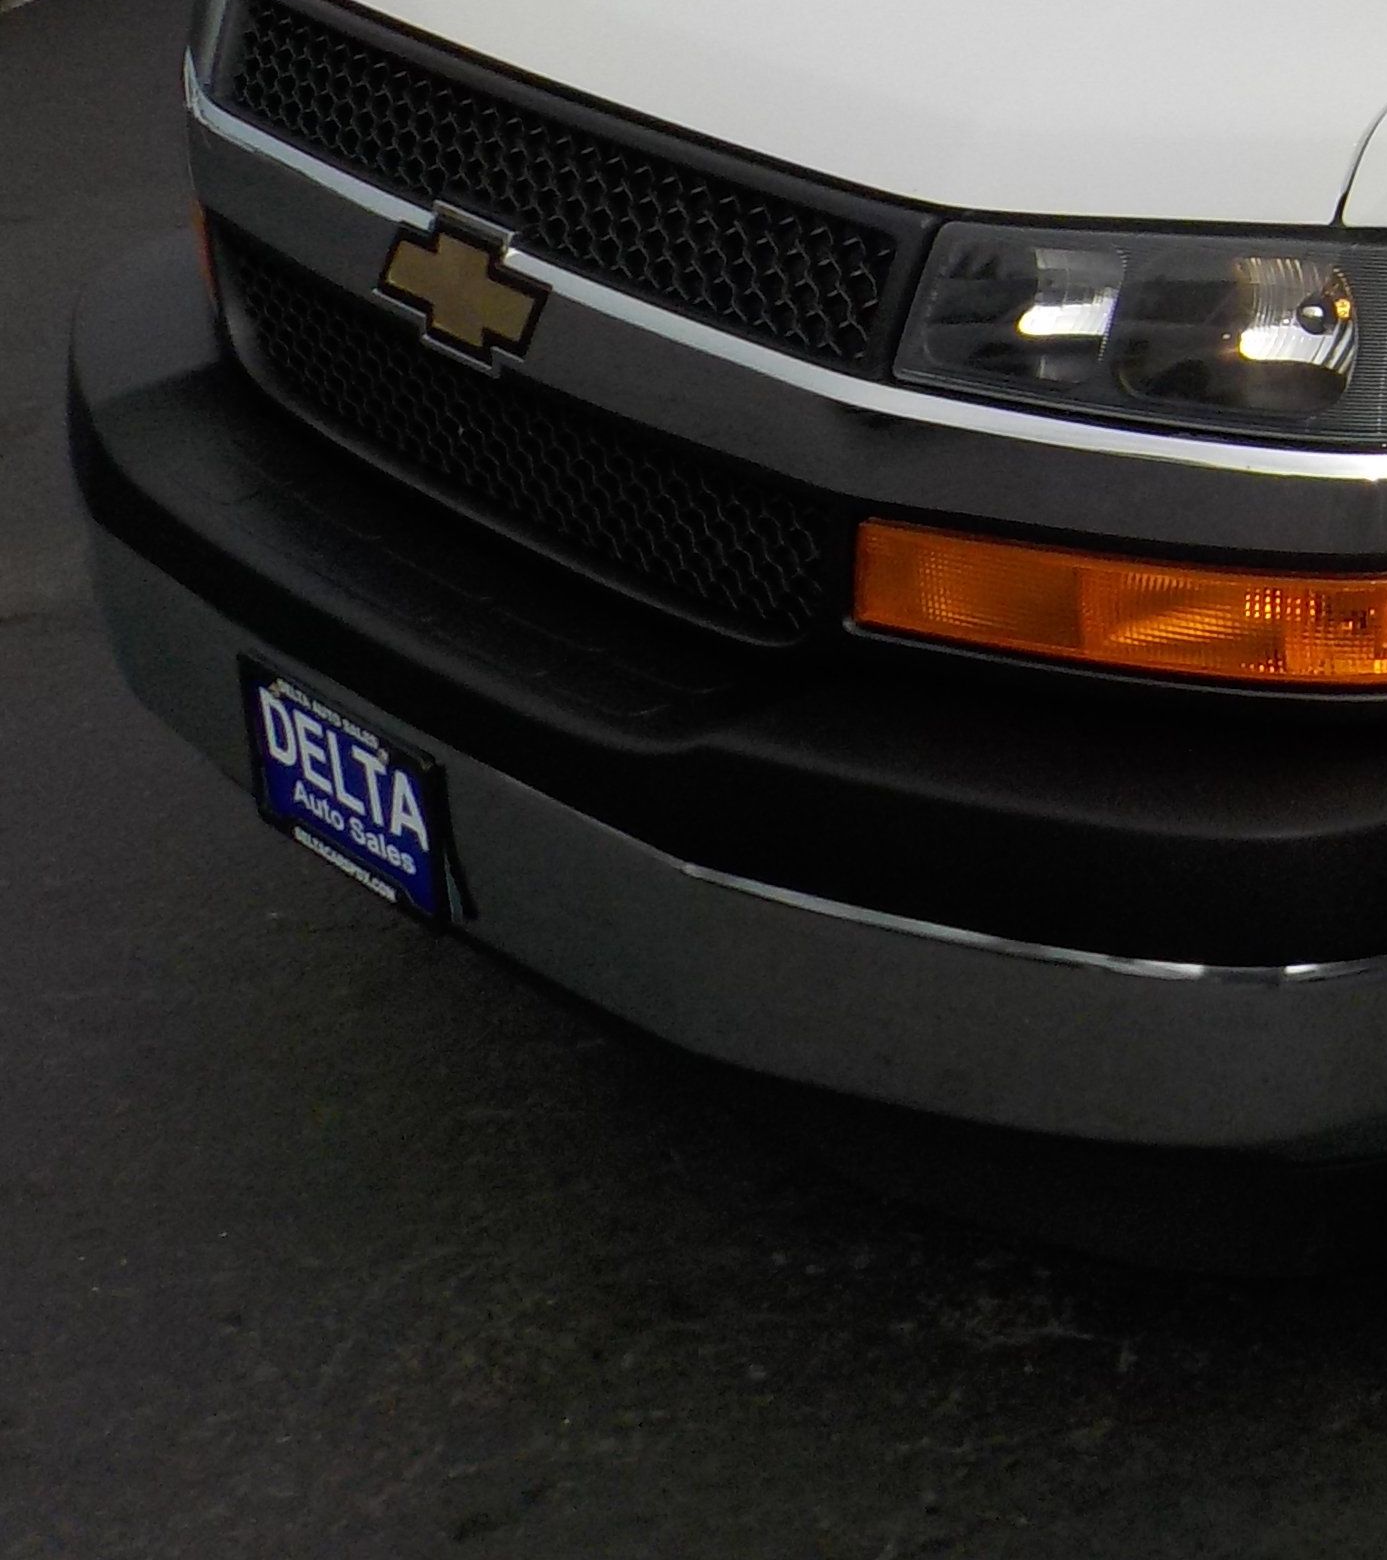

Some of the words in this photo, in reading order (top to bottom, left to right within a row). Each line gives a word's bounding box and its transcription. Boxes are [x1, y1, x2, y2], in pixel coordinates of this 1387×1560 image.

[259, 686, 429, 852] DELTA
[293, 780, 345, 831] Auto
[350, 816, 416, 875] Sales
